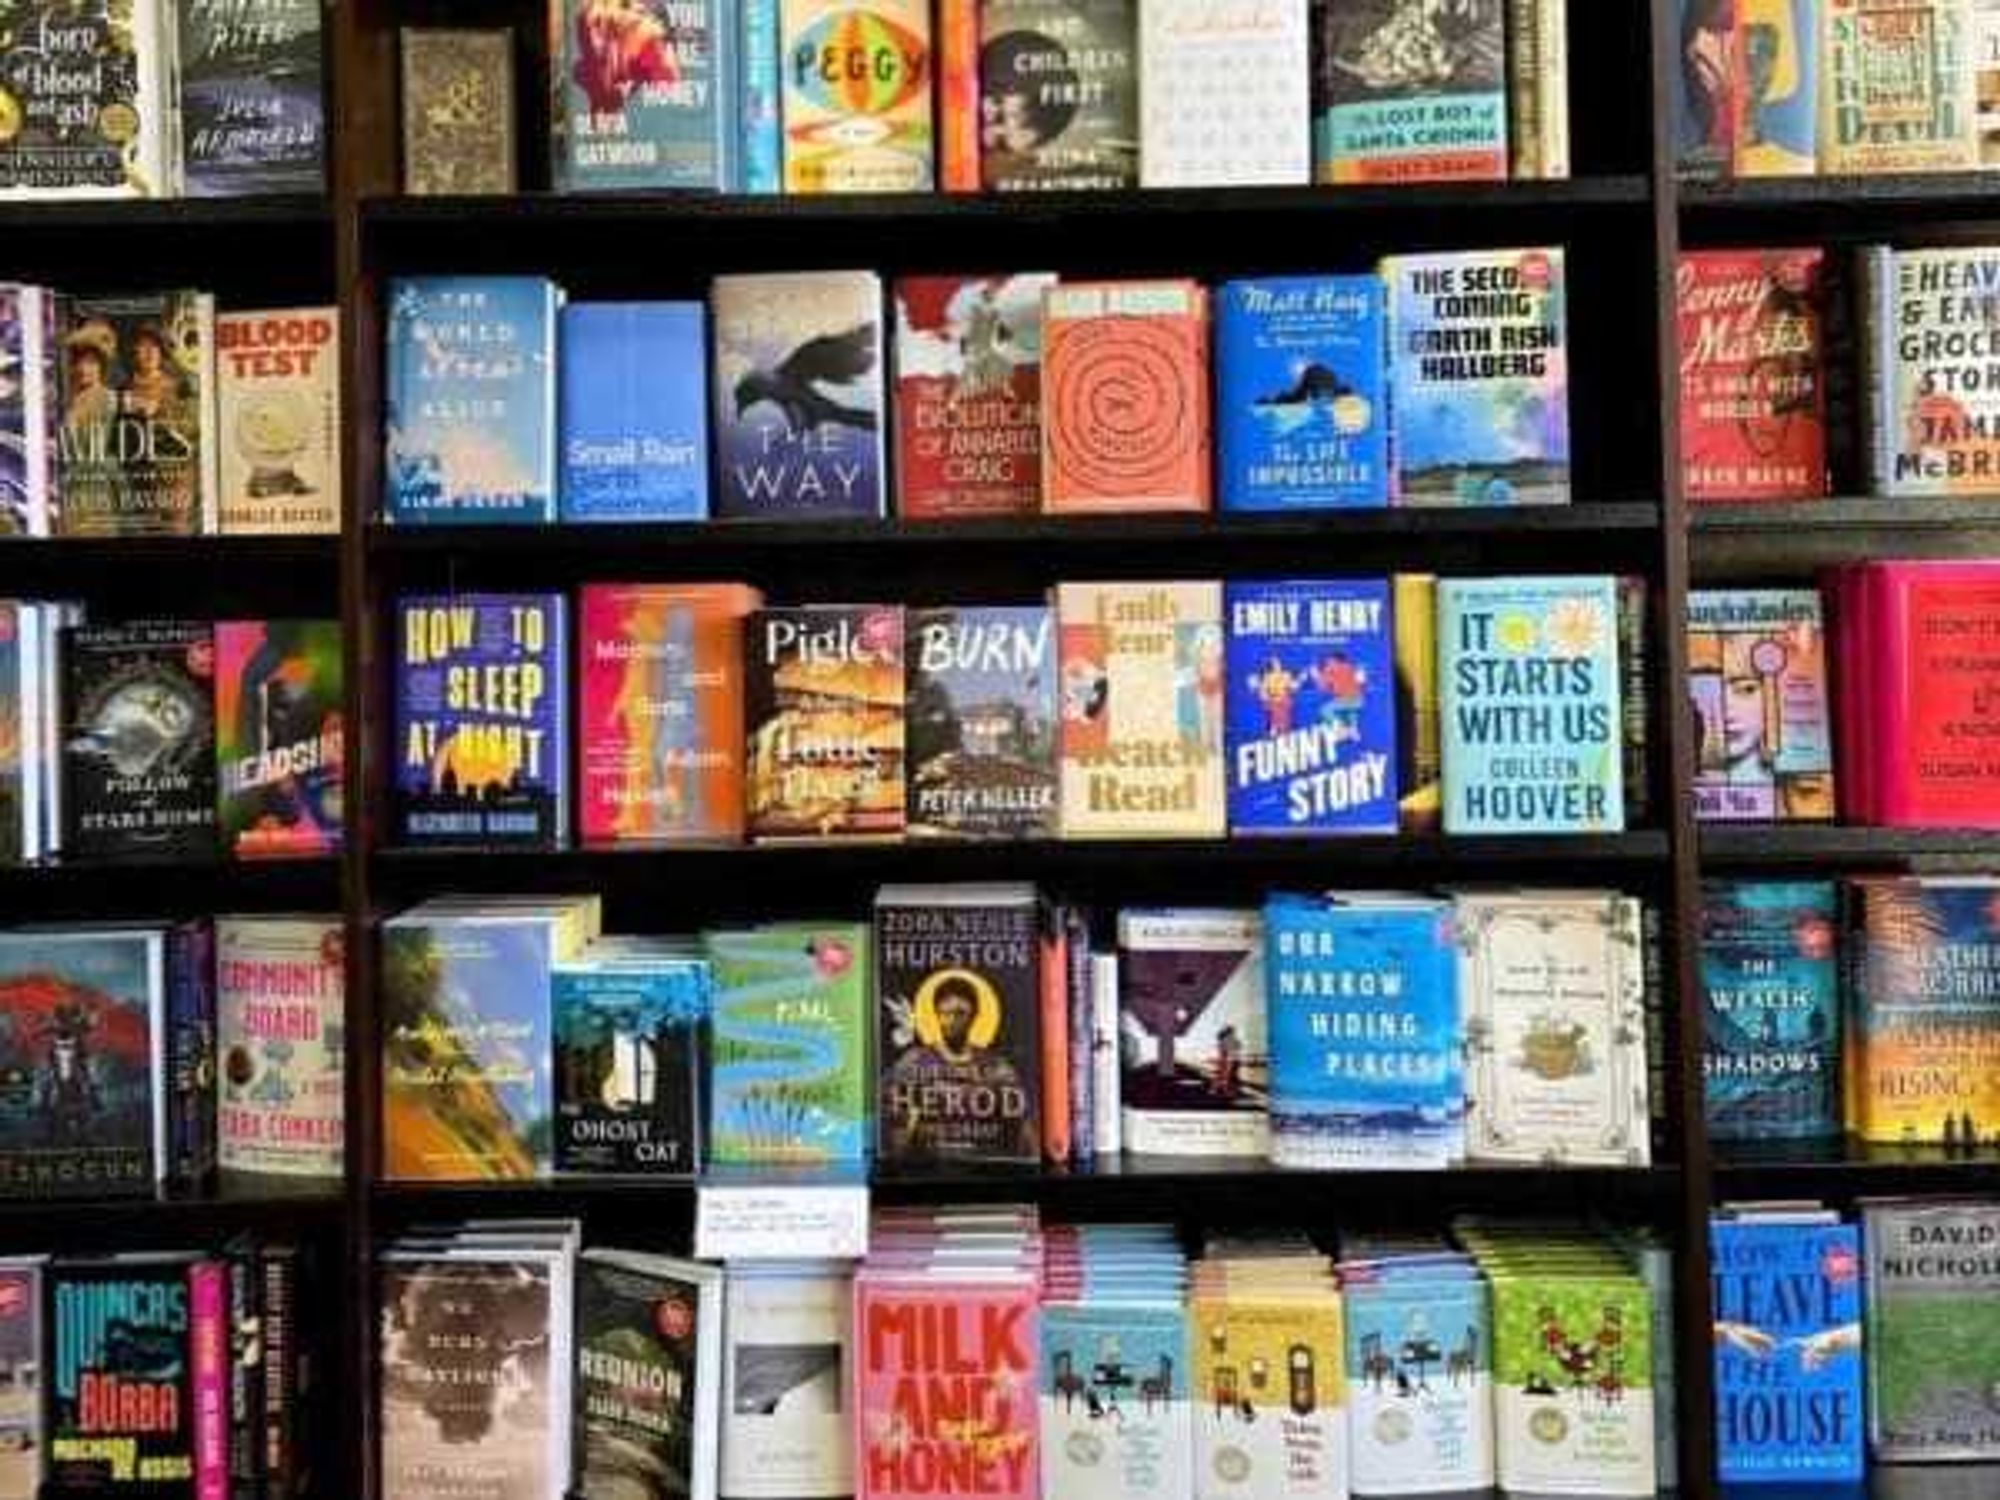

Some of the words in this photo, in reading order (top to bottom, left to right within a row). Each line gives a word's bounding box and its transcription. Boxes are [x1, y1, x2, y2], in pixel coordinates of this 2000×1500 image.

[667, 2, 706, 28] YOU
[793, 42, 927, 88] PEGGY
[1013, 50, 1126, 74] CHILDREN
[33, 62, 101, 95] blood
[1377, 103, 1426, 124] LOST
[1432, 101, 1472, 122] BOY
[1411, 270, 1454, 294] THE
[1240, 287, 1307, 312] Matt
[1432, 294, 1531, 320] COMING
[1901, 299, 1923, 325] &
[216, 318, 332, 348] BLOOD
[1410, 328, 1491, 353] GARTH
[229, 351, 320, 379] TEST
[1420, 353, 1547, 381] HALLBERG
[567, 440, 636, 466] Small
[642, 438, 696, 464] Rain
[758, 426, 846, 454] THE
[737, 464, 861, 499] WAY
[943, 457, 1015, 482] CRAIG
[1249, 463, 1371, 486] IMPOSSIBLE
[1233, 599, 1300, 636] EMILY
[1309, 599, 1382, 633] HENRY
[1460, 612, 1494, 652] IT
[405, 607, 475, 665] HOW
[510, 607, 544, 654] TO
[765, 619, 894, 664] Pigle
[919, 617, 1050, 671] BURN
[448, 663, 543, 718] SLEEP
[1455, 656, 1594, 698] STARTS
[1458, 705, 1550, 744] WITH
[1562, 704, 1611, 744] US
[408, 721, 437, 766] AT
[457, 722, 544, 778] NIGHT
[1237, 724, 1340, 788] FUNNY
[1490, 757, 1580, 779] COLLEEN
[919, 788, 975, 812] PETER
[1088, 772, 1198, 812] Read
[1287, 753, 1388, 822] STORY
[1465, 784, 1607, 822] HOOVER
[885, 942, 1030, 966] HURSTON
[1278, 931, 1334, 956] OUR
[1741, 959, 1776, 975] THE
[1278, 970, 1404, 996] NARROW
[244, 1004, 321, 1041] BOARD
[1310, 1012, 1418, 1038] HIDING
[1700, 1053, 1820, 1076] SHADOWS
[891, 1083, 1026, 1119] HEROD
[1908, 1226, 1995, 1246] DAVID
[1713, 1273, 1842, 1326] LEAVE
[867, 1302, 1030, 1373] MILK
[580, 1347, 682, 1401] REUNION
[891, 1374, 1014, 1440] AND
[867, 1440, 1030, 1495] HONEY
